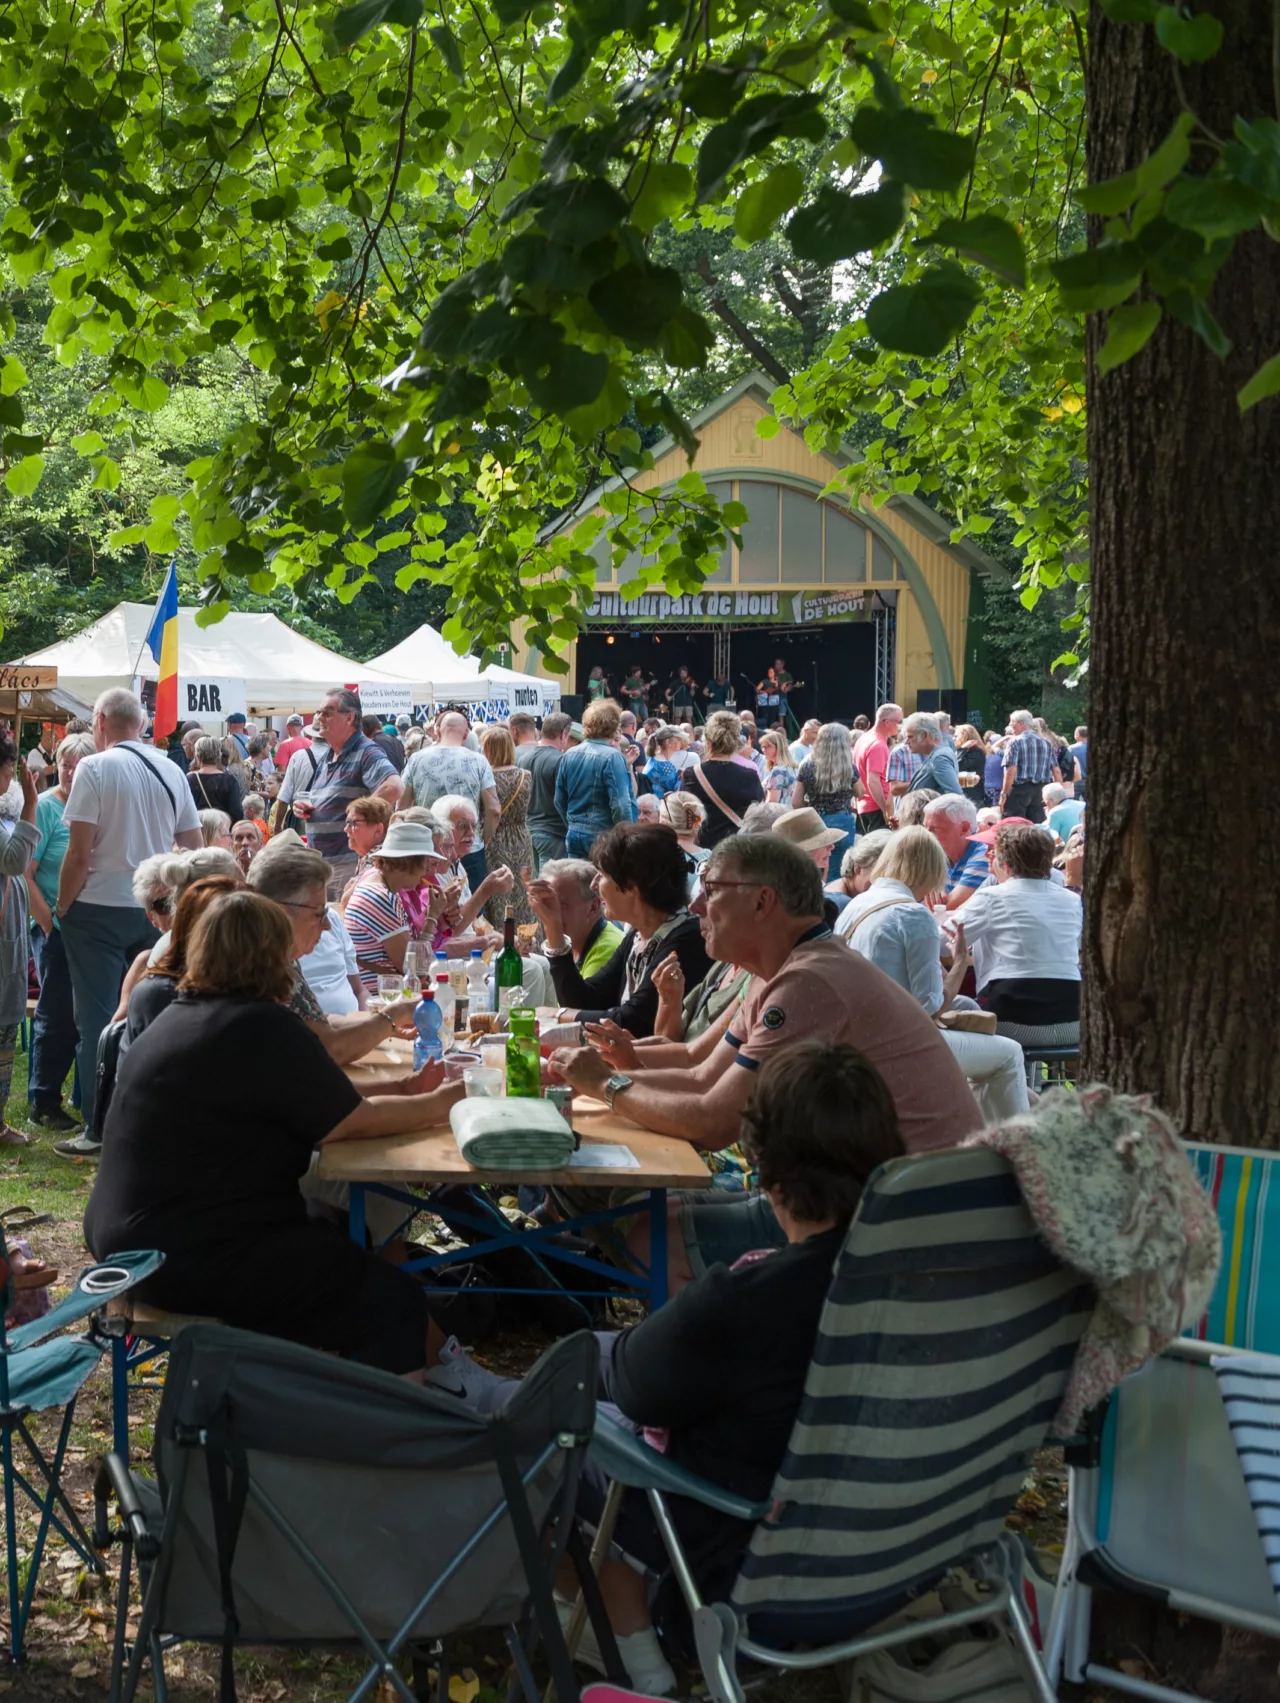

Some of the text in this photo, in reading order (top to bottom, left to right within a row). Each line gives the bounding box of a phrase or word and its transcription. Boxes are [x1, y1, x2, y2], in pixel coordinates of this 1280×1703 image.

[585, 591, 779, 620] Cultuurpark de Hout
[804, 597, 865, 621] DE HOUT
[187, 683, 222, 712] BAR
[514, 685, 538, 707] munten
